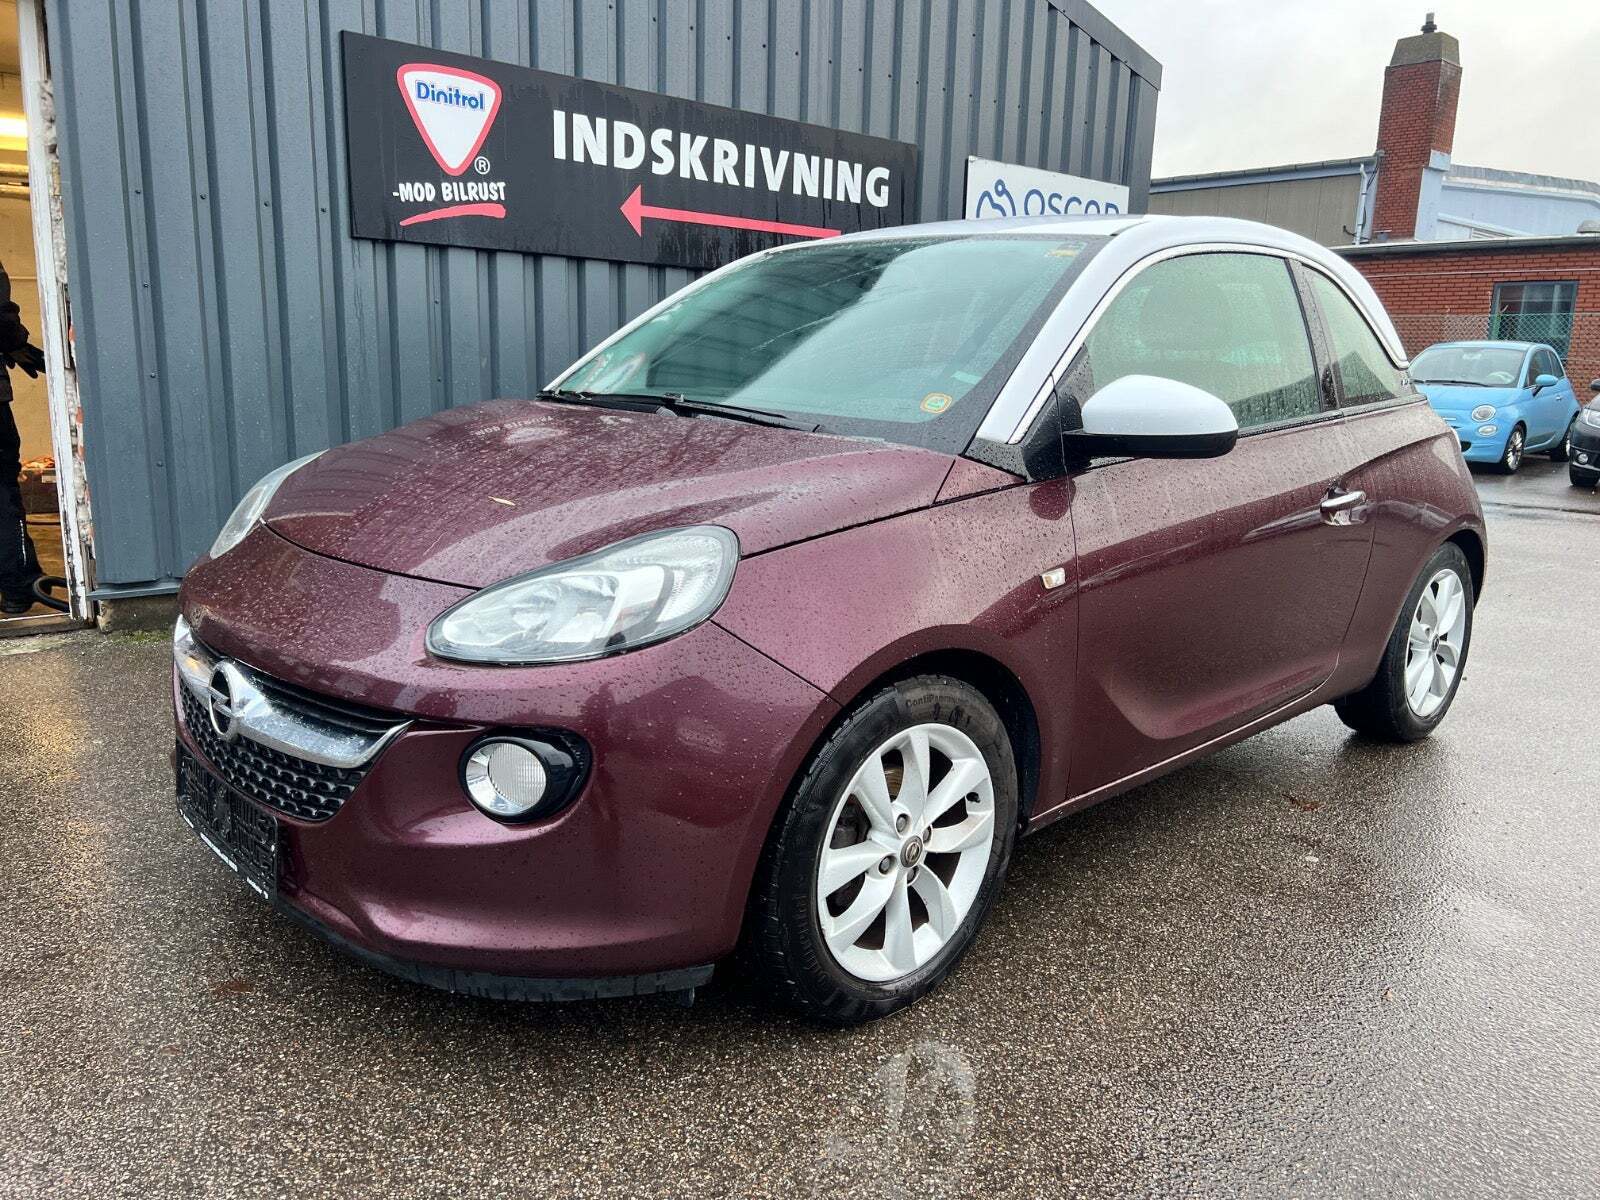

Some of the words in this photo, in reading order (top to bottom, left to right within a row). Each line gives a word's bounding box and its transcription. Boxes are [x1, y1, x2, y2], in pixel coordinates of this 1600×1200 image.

[416, 81, 485, 110] Dinitrol
[553, 109, 890, 208] INDSKRIVNING
[441, 181, 506, 202] BILRUST
